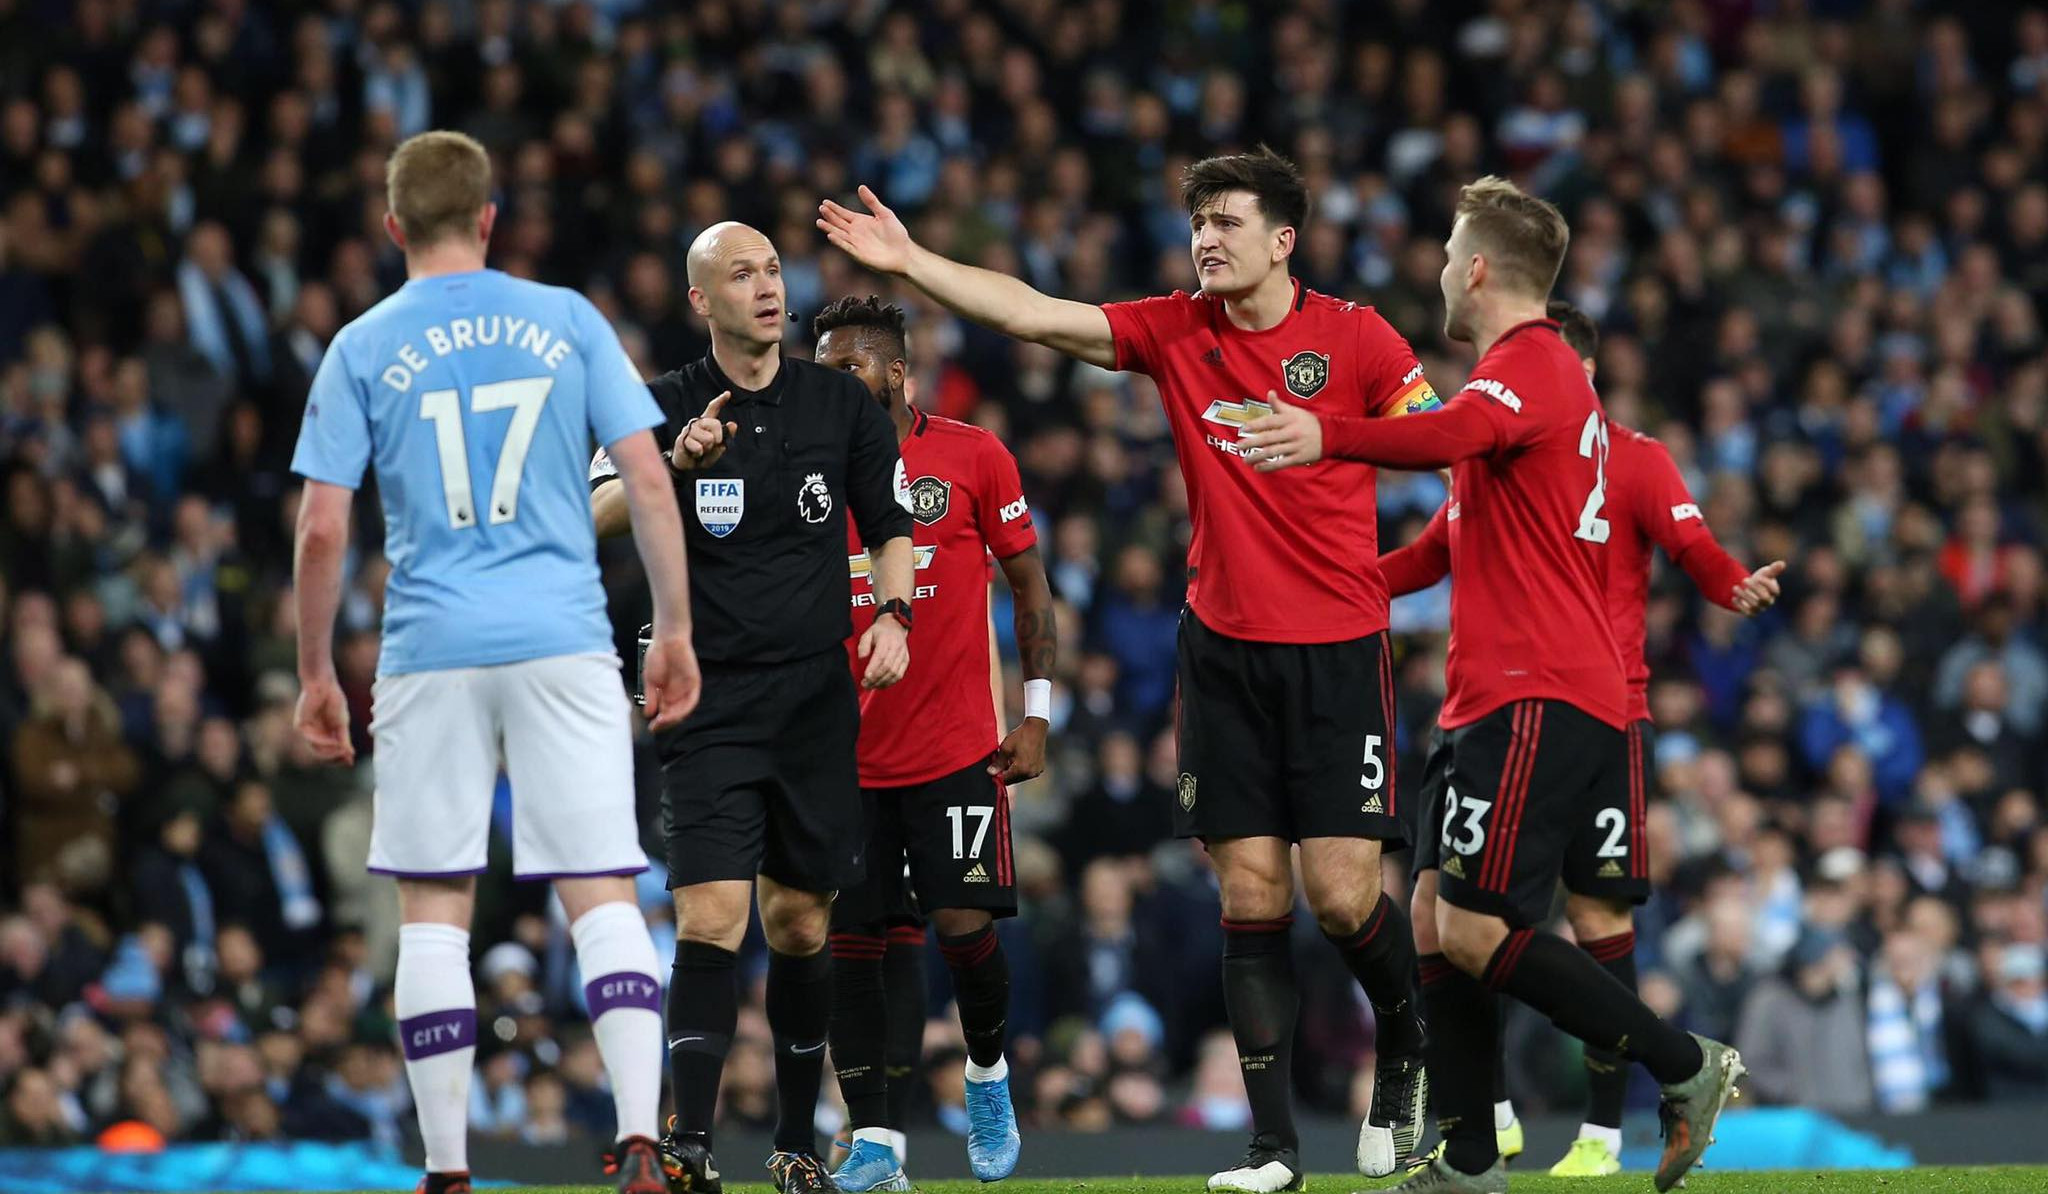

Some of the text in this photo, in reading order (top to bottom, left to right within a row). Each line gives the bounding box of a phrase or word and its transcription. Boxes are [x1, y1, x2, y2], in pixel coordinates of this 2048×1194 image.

[382, 315, 571, 392] DE BRUYNE
[419, 377, 554, 530] 17
[700, 483, 739, 497] FIFA
[700, 506, 739, 514] REFEREE
[1360, 734, 1384, 790] 5
[946, 805, 995, 860] 17
[1441, 785, 1492, 856] 23
[1595, 807, 1628, 858] 2
[963, 875, 990, 883] adidas
[602, 978, 655, 999] CITY
[413, 1022, 462, 1047] CITY
